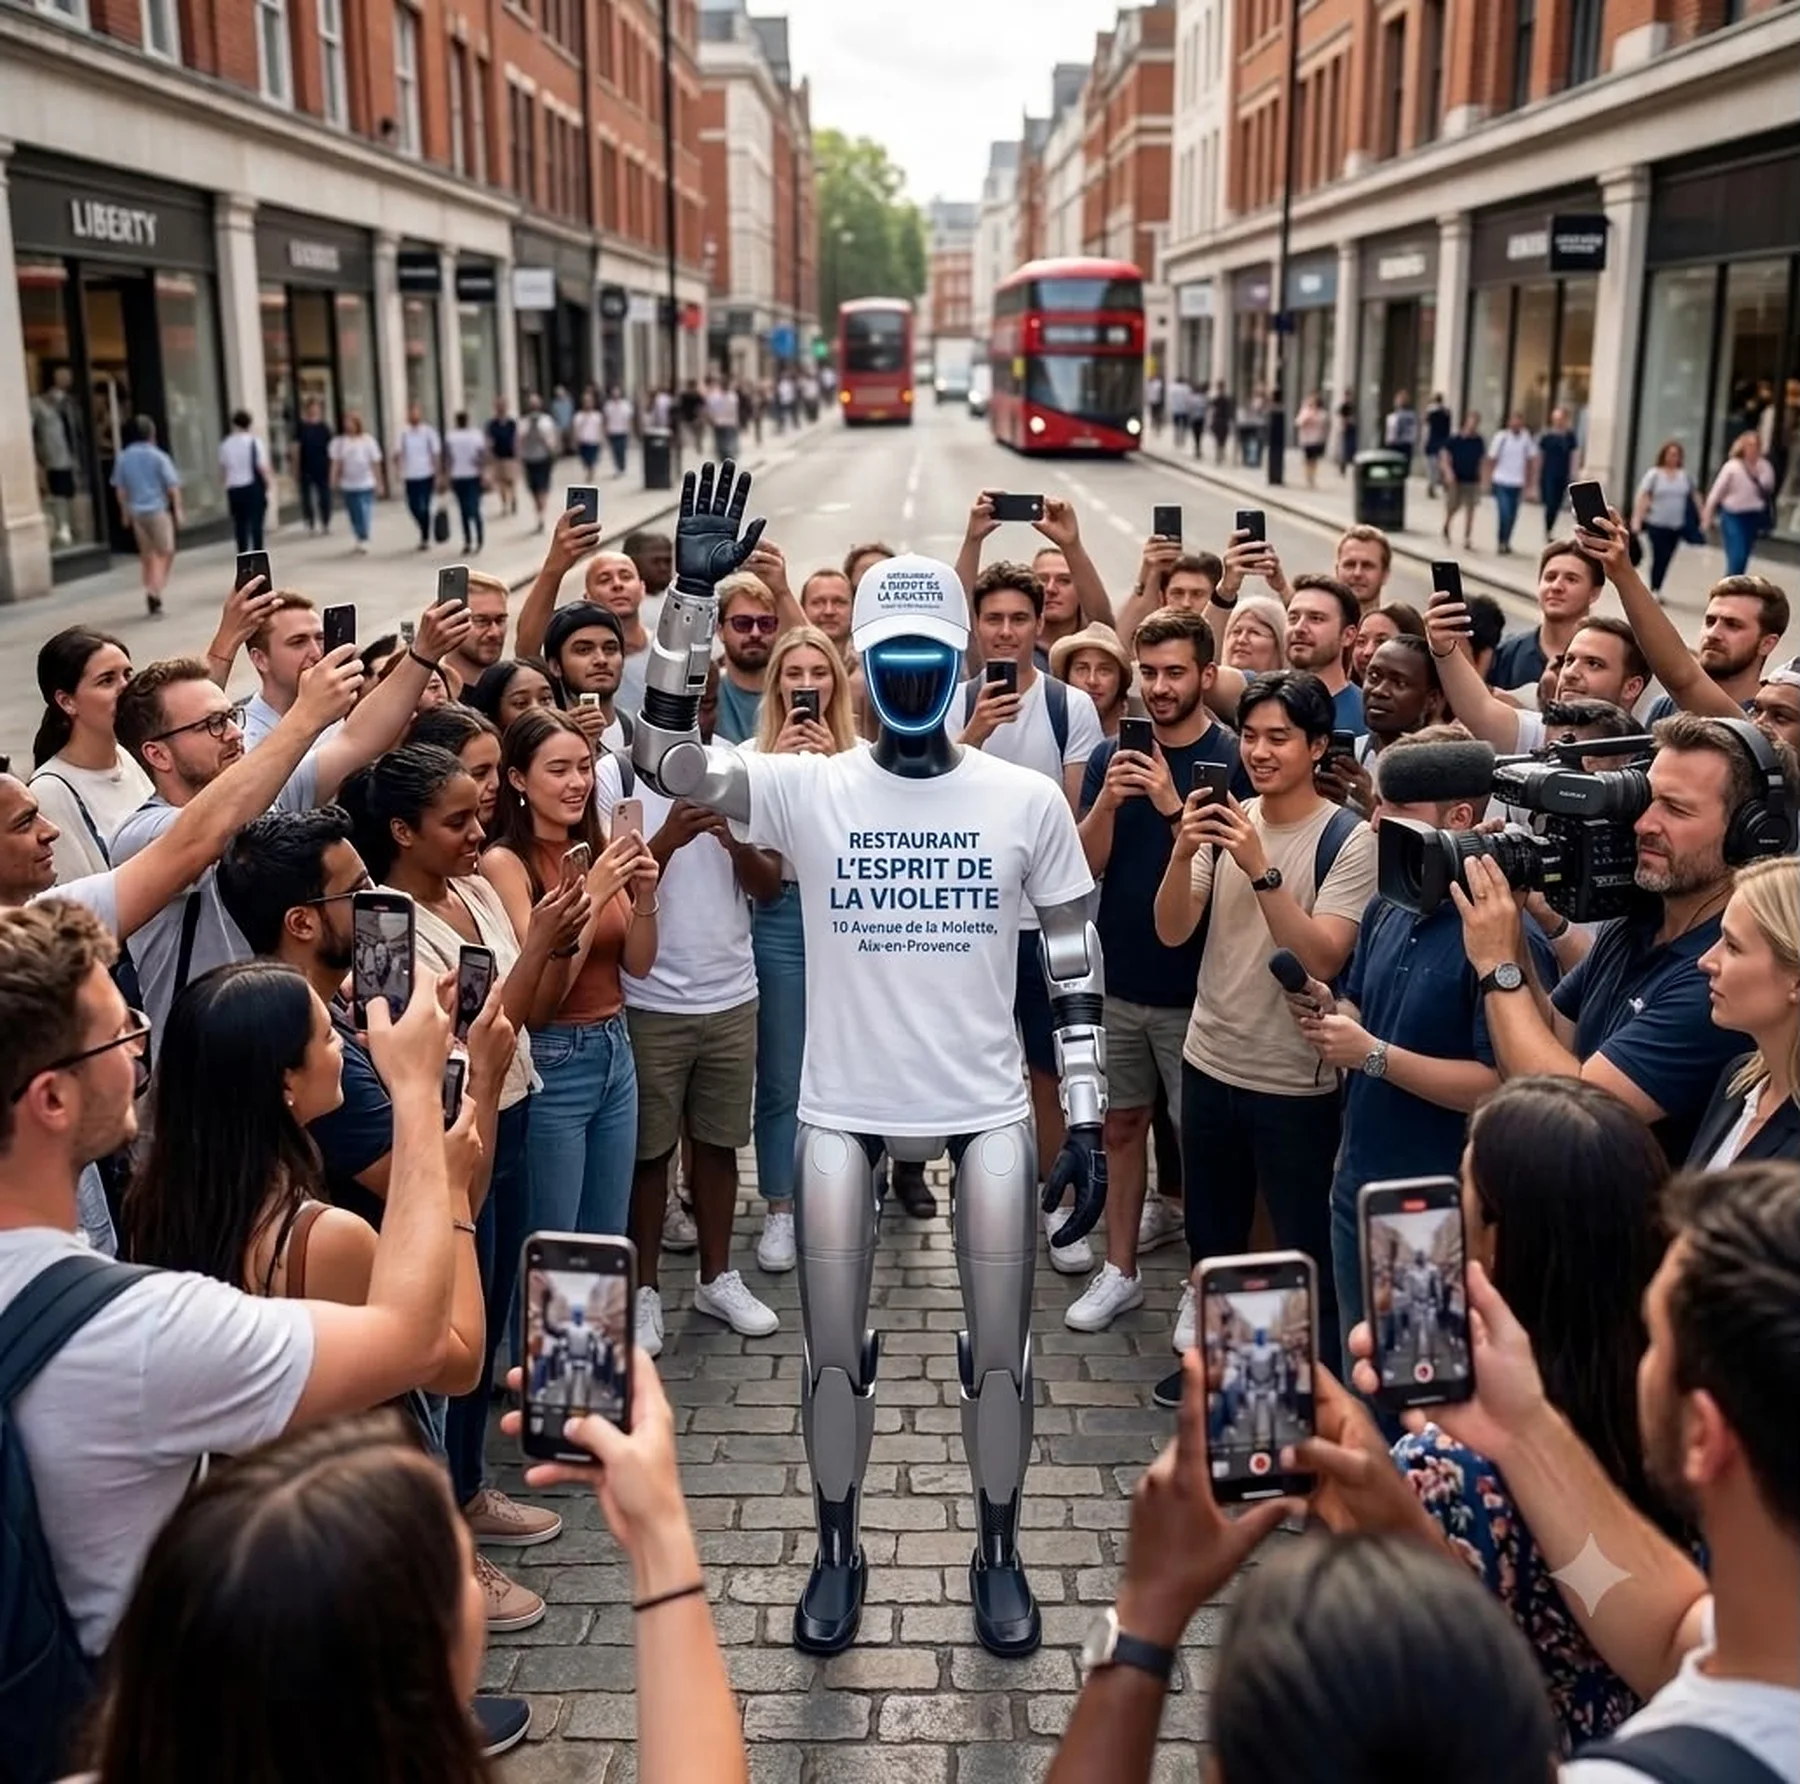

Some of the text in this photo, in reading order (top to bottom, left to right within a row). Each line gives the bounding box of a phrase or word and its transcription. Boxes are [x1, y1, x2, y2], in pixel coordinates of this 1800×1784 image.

[71, 199, 157, 246] LIBERTY
[849, 832, 980, 849] RESTAURANT
[837, 858, 993, 880] L'ESPRIT DE
[830, 887, 999, 910] LA VIOLETTE
[832, 920, 998, 935] 10 Avenue de la Molette,
[858, 939, 971, 952] Aix-en-Provence
